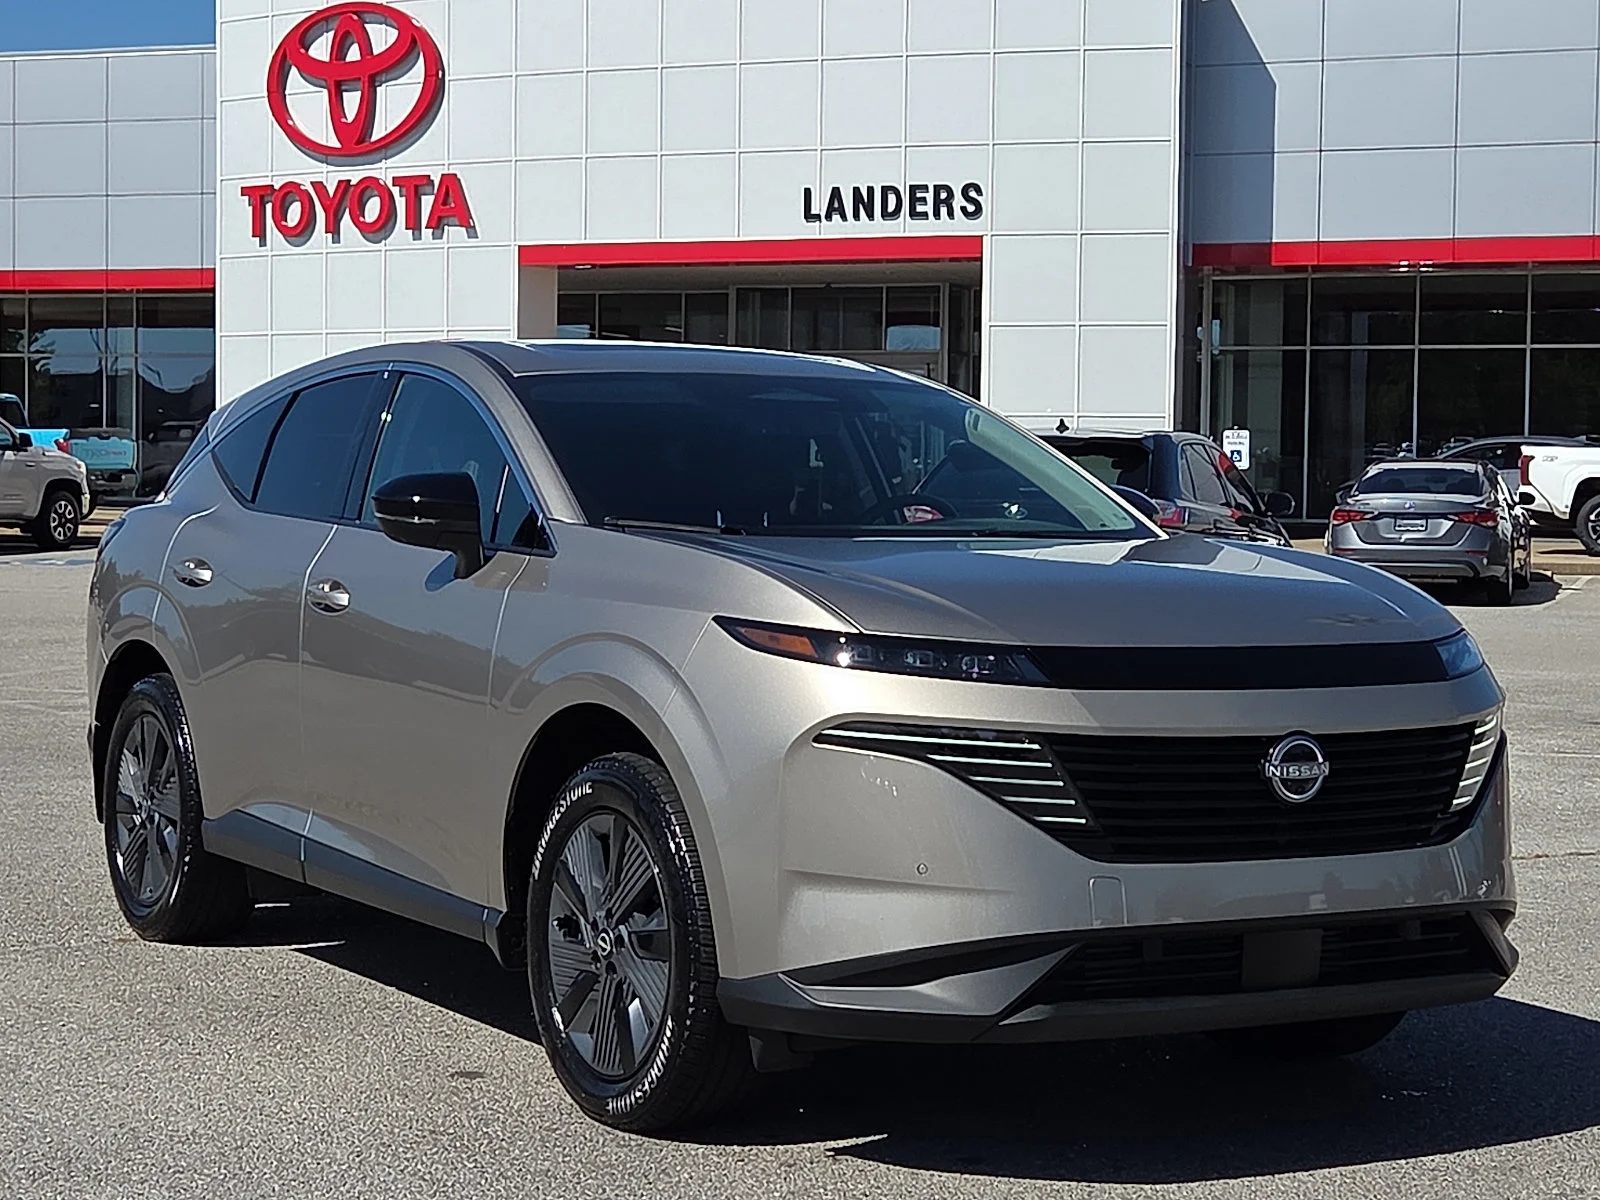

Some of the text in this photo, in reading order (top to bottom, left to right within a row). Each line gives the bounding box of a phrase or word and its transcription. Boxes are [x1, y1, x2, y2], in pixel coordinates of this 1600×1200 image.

[240, 173, 476, 246] TOYOTA
[803, 182, 984, 222] LANDERS
[1268, 763, 1328, 778] NISSAN
